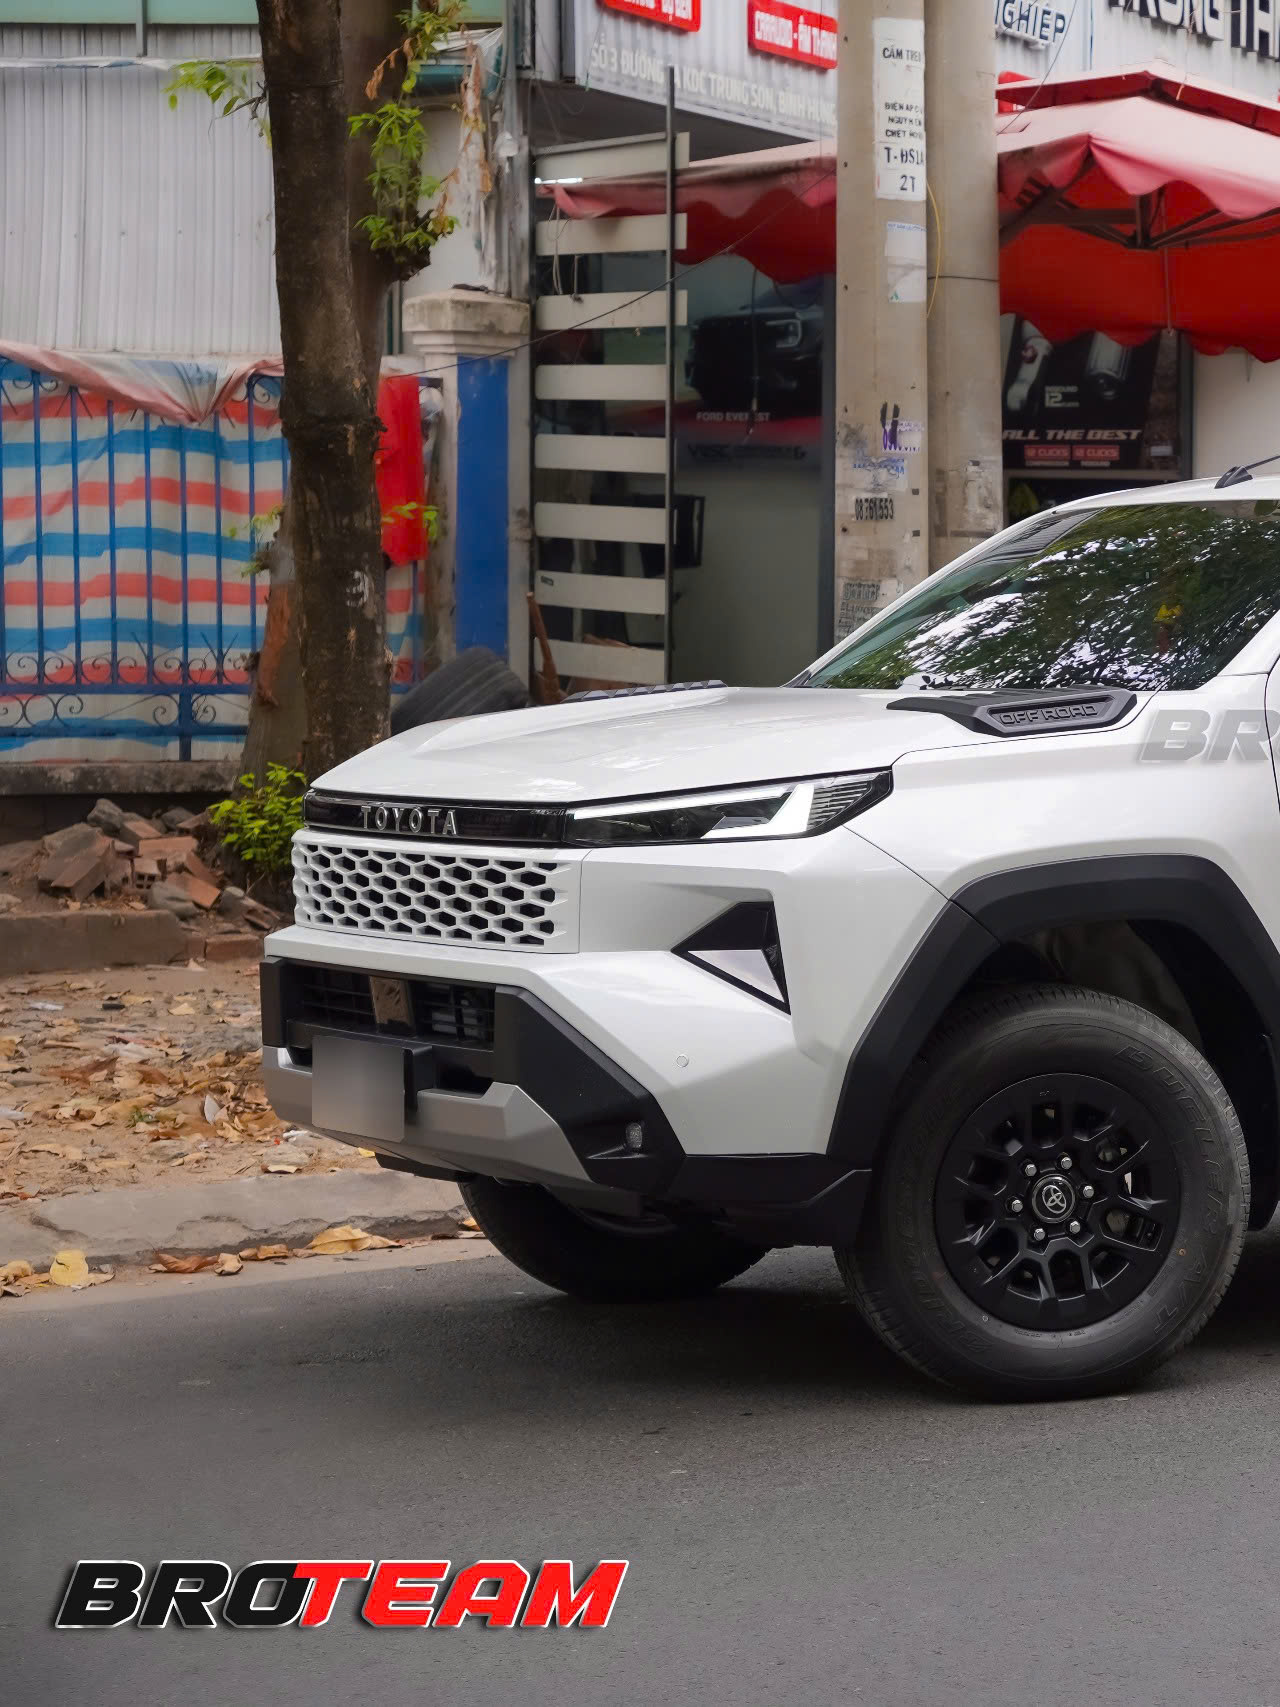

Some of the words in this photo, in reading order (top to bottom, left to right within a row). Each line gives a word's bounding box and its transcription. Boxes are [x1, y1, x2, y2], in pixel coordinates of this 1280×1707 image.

[696, 411, 724, 422] FORD
[726, 411, 771, 422] EVEST
[1046, 430, 1085, 440] THE
[1086, 430, 1142, 440] BEST
[361, 806, 458, 835] TOYOTA
